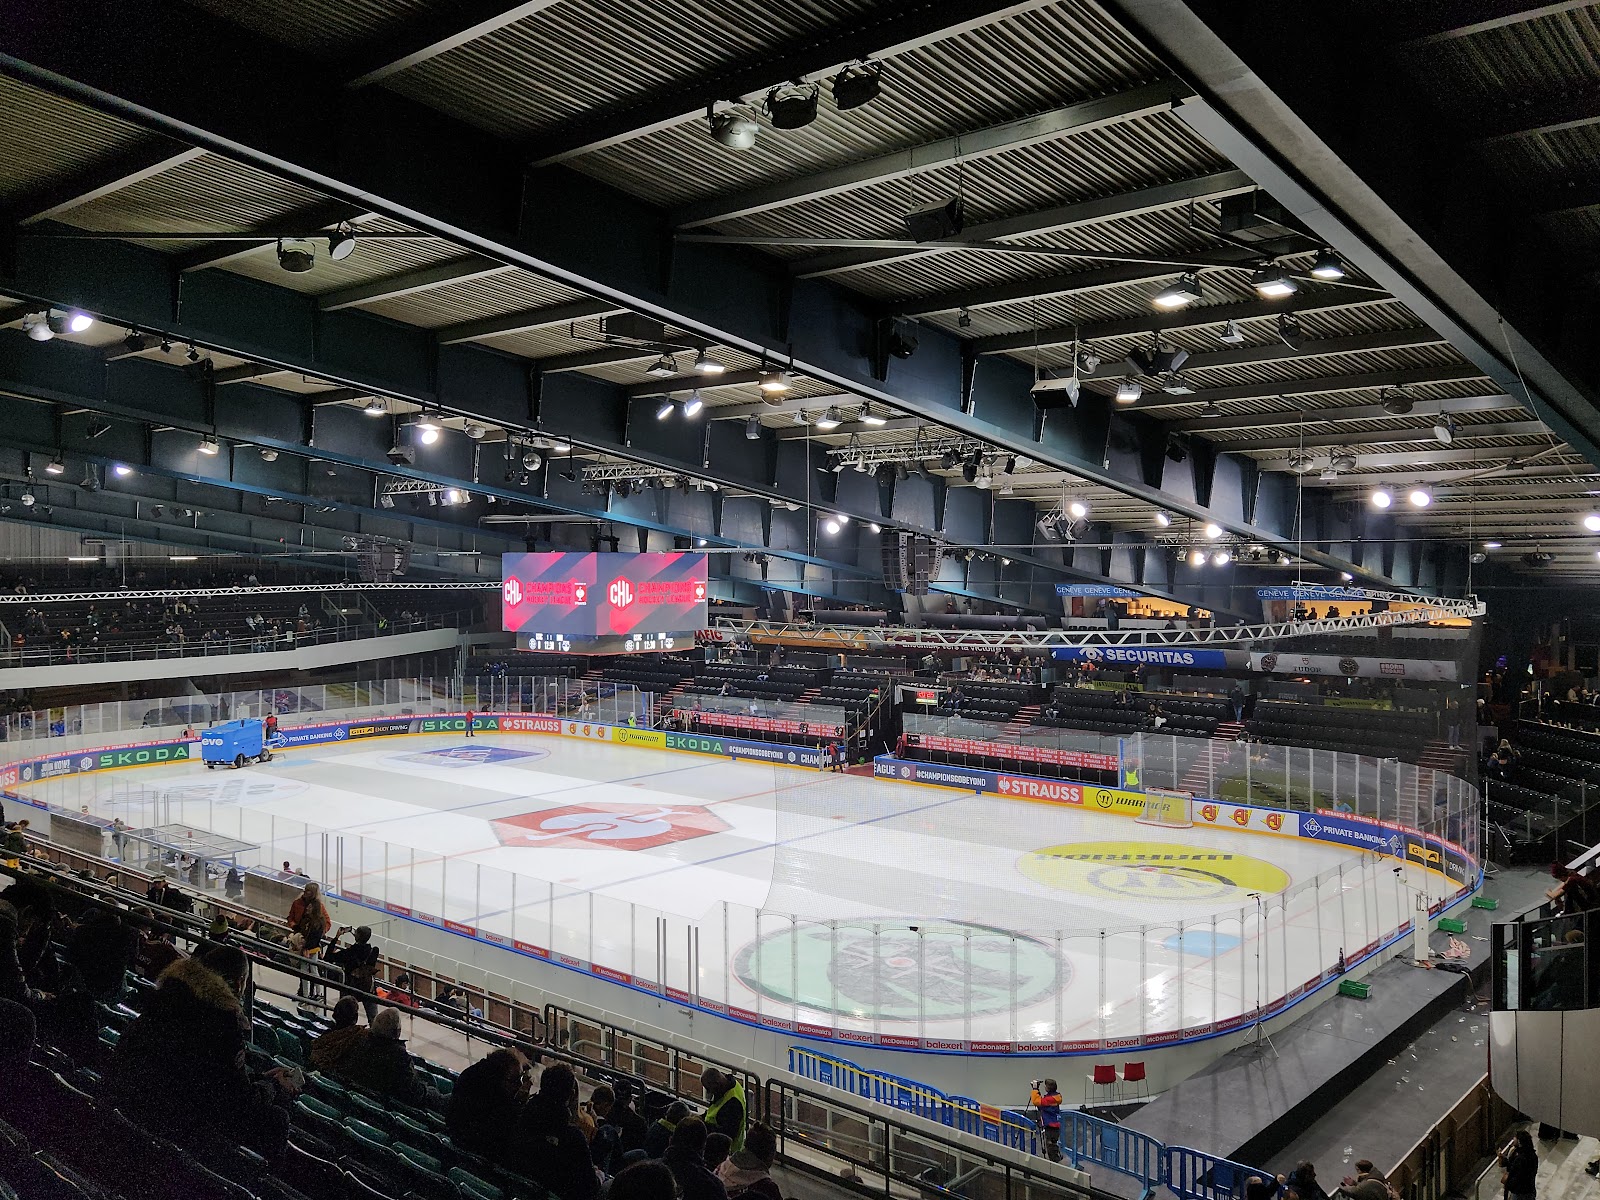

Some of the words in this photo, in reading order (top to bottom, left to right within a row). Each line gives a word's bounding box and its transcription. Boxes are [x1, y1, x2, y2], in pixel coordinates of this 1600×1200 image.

[504, 580, 522, 606] CHL
[525, 582, 572, 594] CHAMPIONS
[610, 580, 633, 607] CHL
[1106, 650, 1194, 665] SECURITAS
[513, 718, 559, 731] STRAUSS
[202, 738, 223, 746] evo
[289, 734, 310, 743] PRIVATE
[310, 732, 333, 740] BANKING
[916, 769, 986, 787] #CHAMPIONSGOBEYOND
[1011, 780, 1080, 801] STRAUSS
[1324, 810, 1345, 818] STRAUSS
[1353, 815, 1372, 824] STRAUSS
[1307, 823, 1318, 832] LGT
[1323, 825, 1353, 838] PRIVATE
[1354, 830, 1387, 847] BANKING
[635, 978, 658, 992] balexert
[700, 998, 724, 1013] balexert
[729, 1008, 756, 1021] McDonald's
[762, 1017, 792, 1030] balexert
[798, 1025, 832, 1037] McDonald's
[838, 1031, 873, 1043] balexert
[1184, 1025, 1212, 1038] balexert
[881, 1037, 919, 1047] McDonald's
[1106, 1037, 1140, 1048] balexert
[1146, 1033, 1178, 1043] McDonald's
[926, 1040, 963, 1050] balexert
[972, 1043, 1010, 1052] McDonald's
[1017, 1043, 1054, 1052] balexert
[1063, 1042, 1099, 1050] McDonald's
